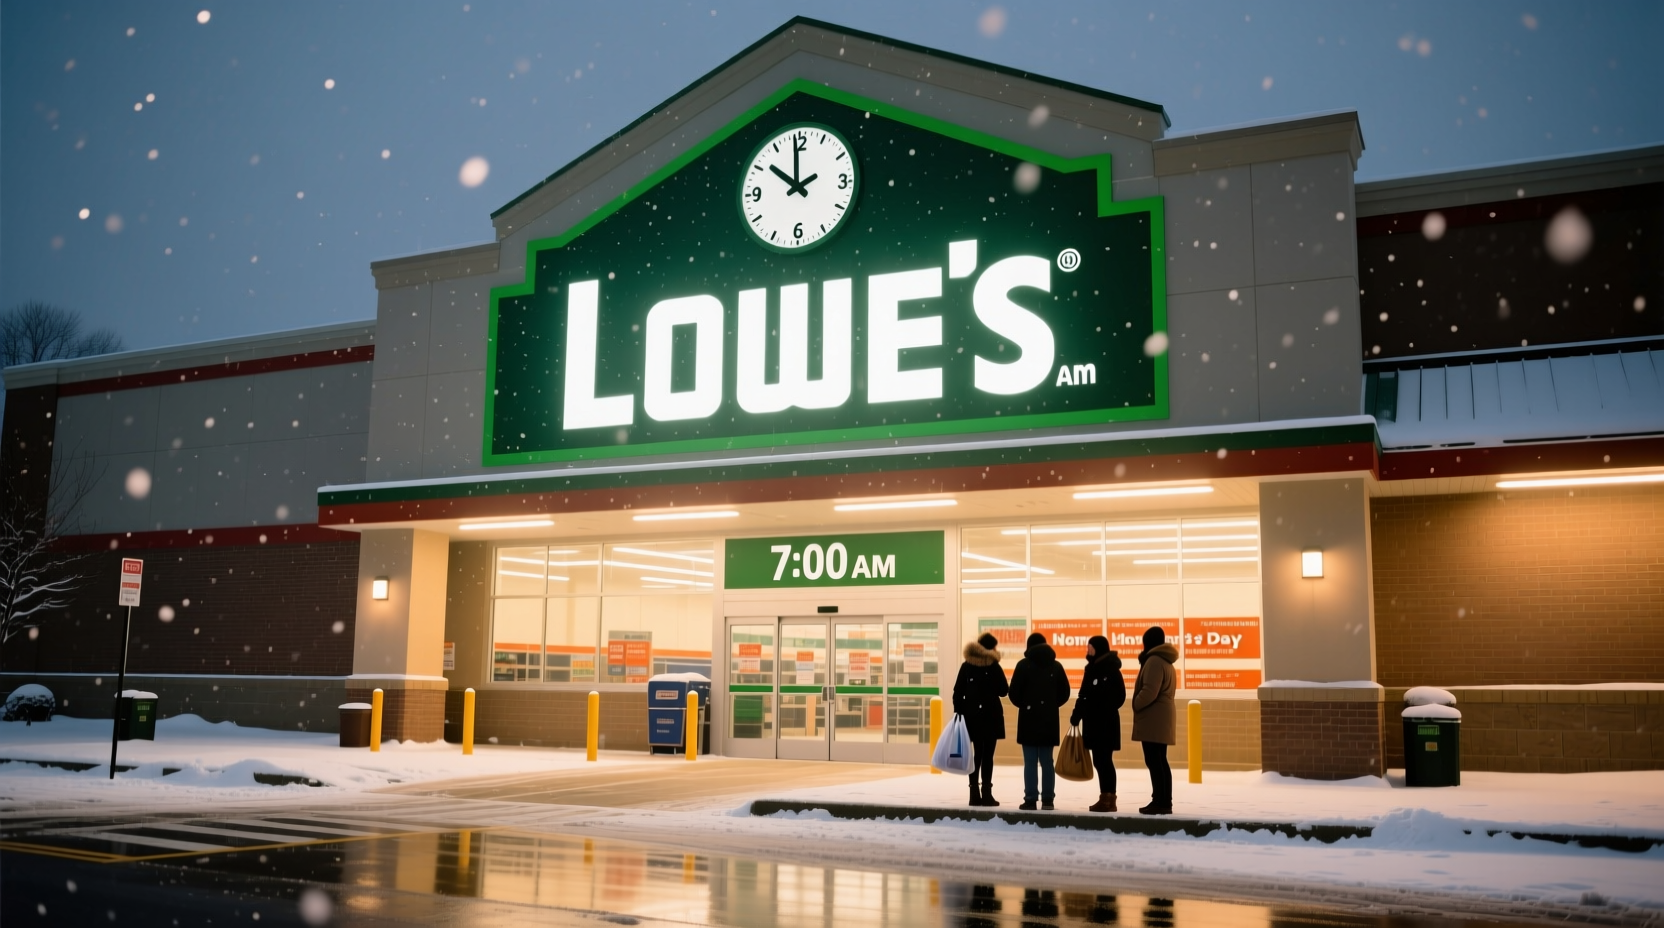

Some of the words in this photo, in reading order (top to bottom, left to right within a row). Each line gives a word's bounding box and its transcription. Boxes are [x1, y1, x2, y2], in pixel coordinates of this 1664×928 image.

[837, 173, 848, 190] 3
[752, 186, 762, 203] 9
[793, 222, 804, 239] 6
[562, 238, 1056, 431] LOWE'S
[770, 541, 848, 581] 7:00
[850, 554, 896, 579] AM
[1206, 631, 1243, 650] Day
